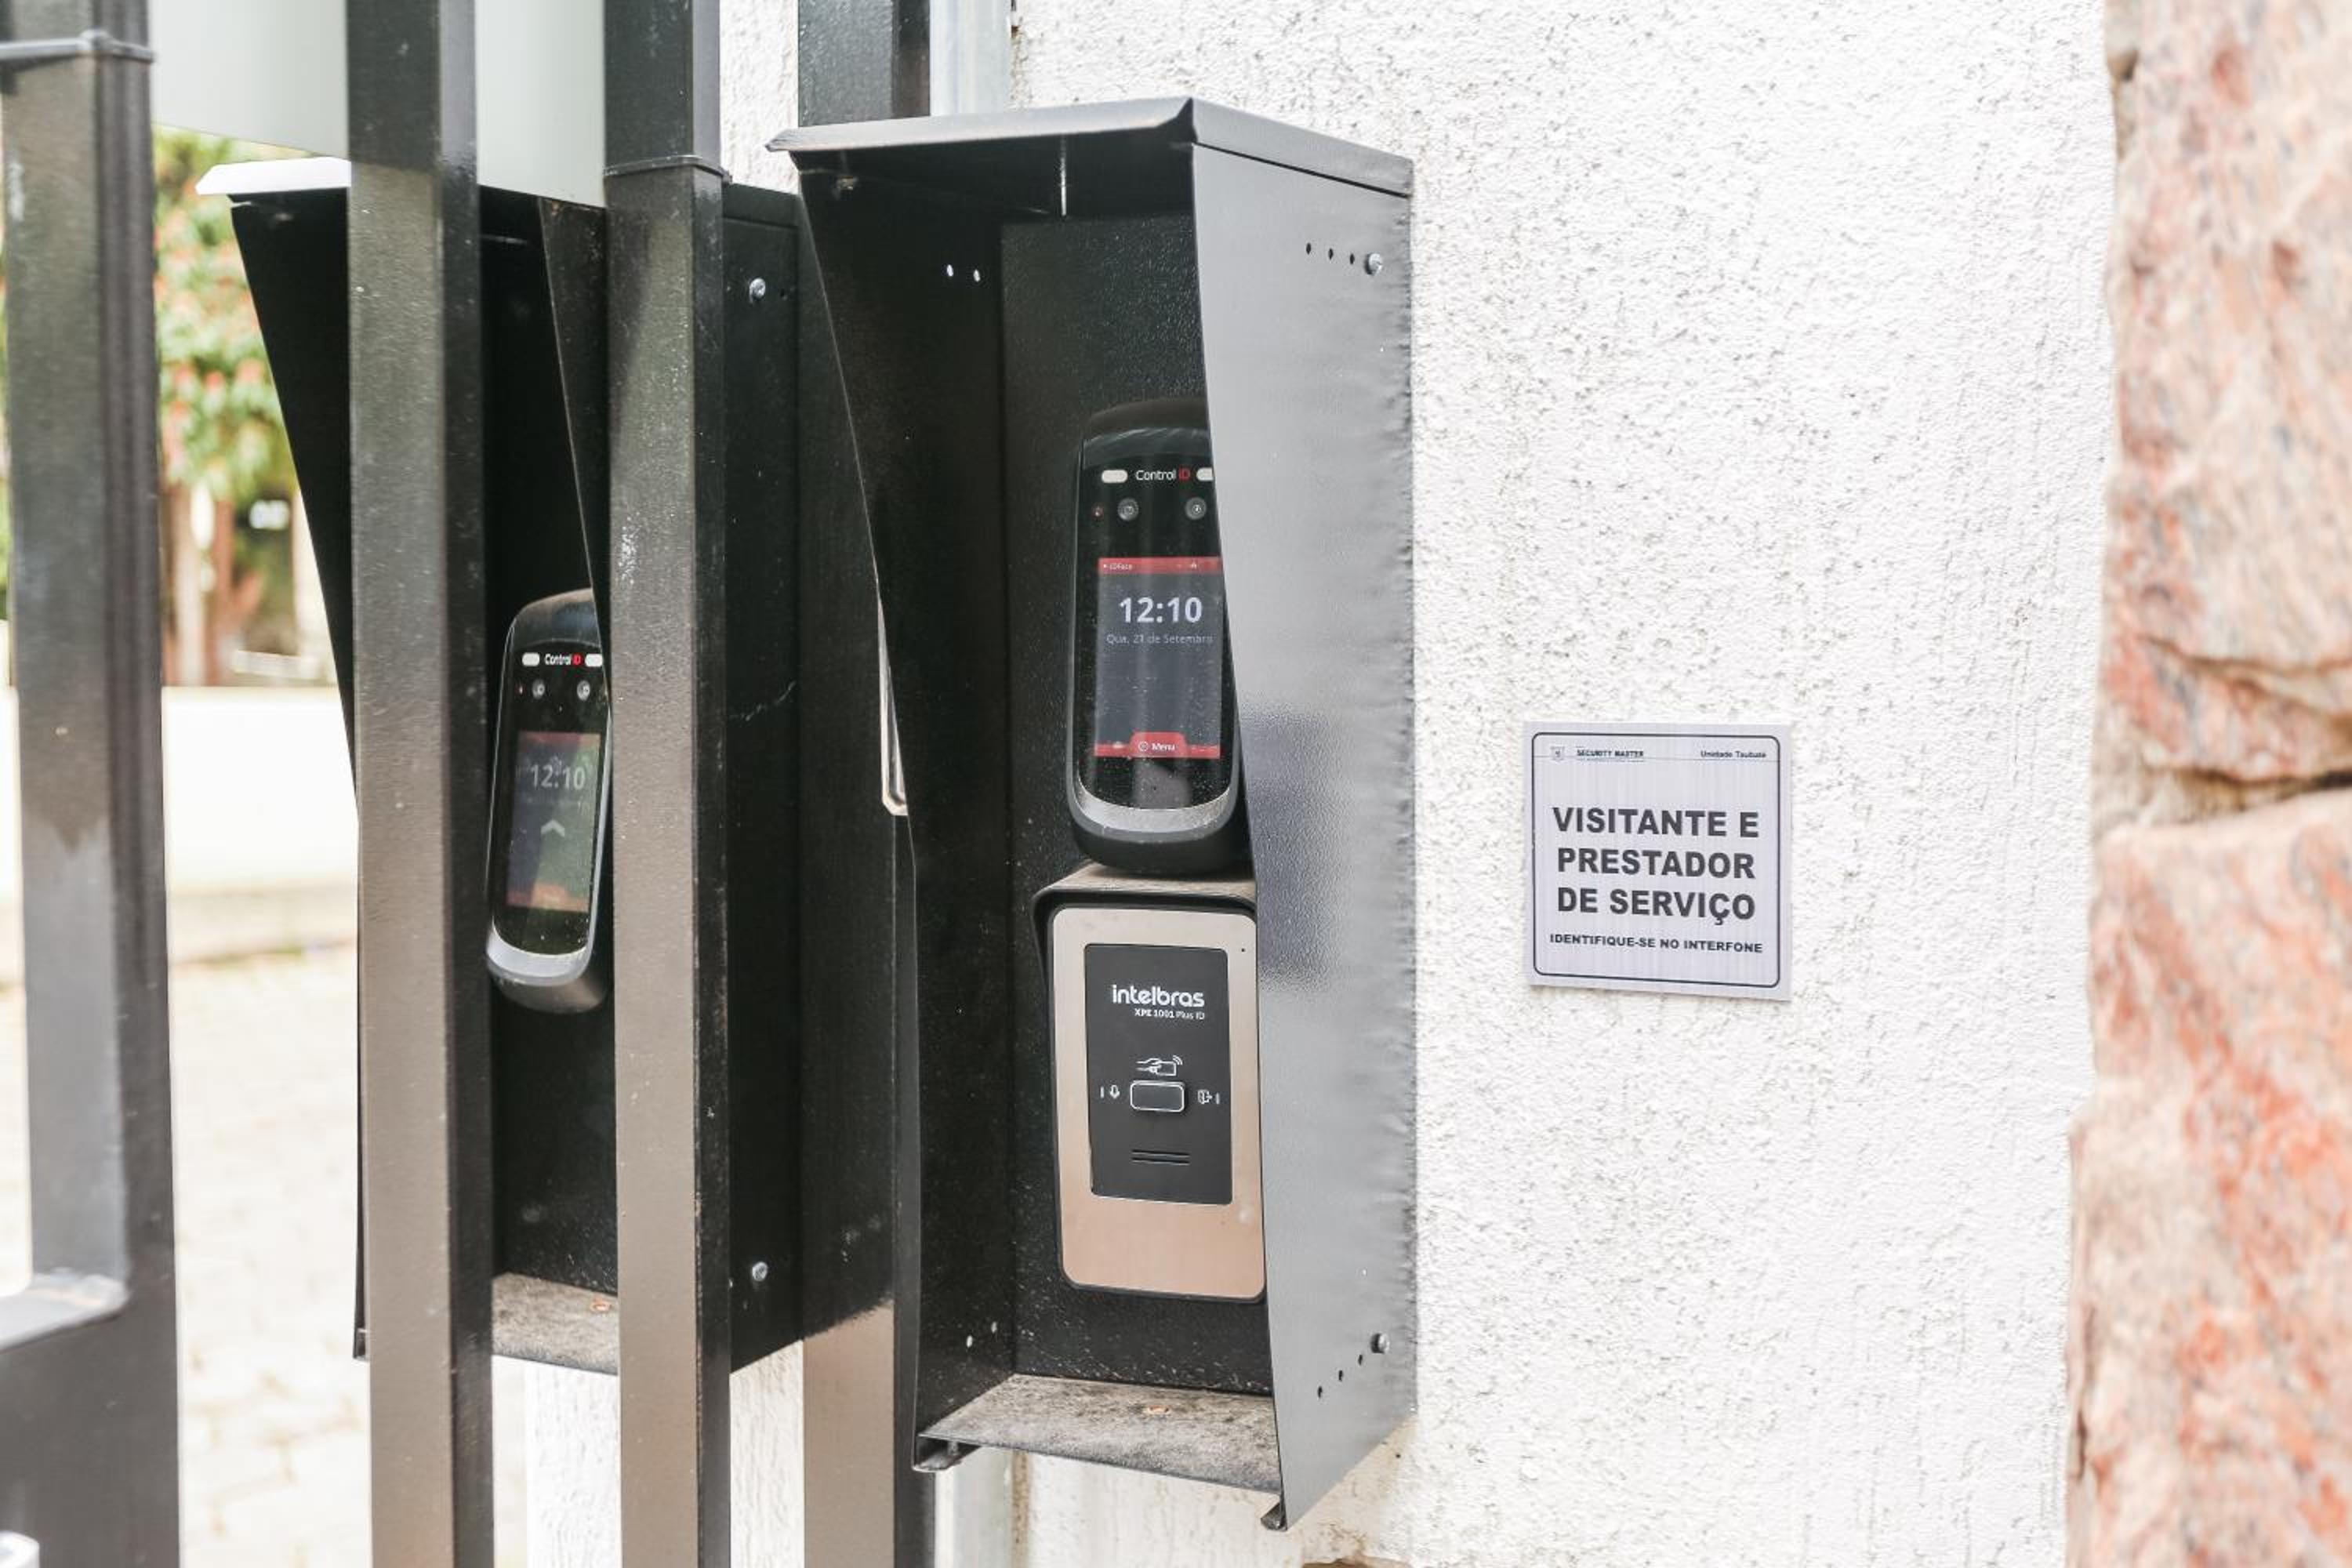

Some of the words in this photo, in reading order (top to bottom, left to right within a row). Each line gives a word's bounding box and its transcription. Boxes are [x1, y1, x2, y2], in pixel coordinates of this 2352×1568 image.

[1136, 468, 1176, 481] Control
[1119, 597, 1203, 623] 12:10
[1148, 633, 1161, 644] de
[544, 653, 572, 666] Control
[1151, 742, 1176, 751] Menu
[1553, 807, 1727, 837] VISITANTE
[1740, 811, 1759, 837] E
[1558, 848, 1756, 880] PRESTADOR
[1558, 887, 1598, 913] DE
[1610, 889, 1755, 926] SERVIÇO
[1550, 934, 1656, 949] IDENTIFIQUE-SE
[1660, 939, 1679, 949] NO
[1685, 940, 1763, 953] INTERFONE
[1112, 984, 1206, 1007] intelbras
